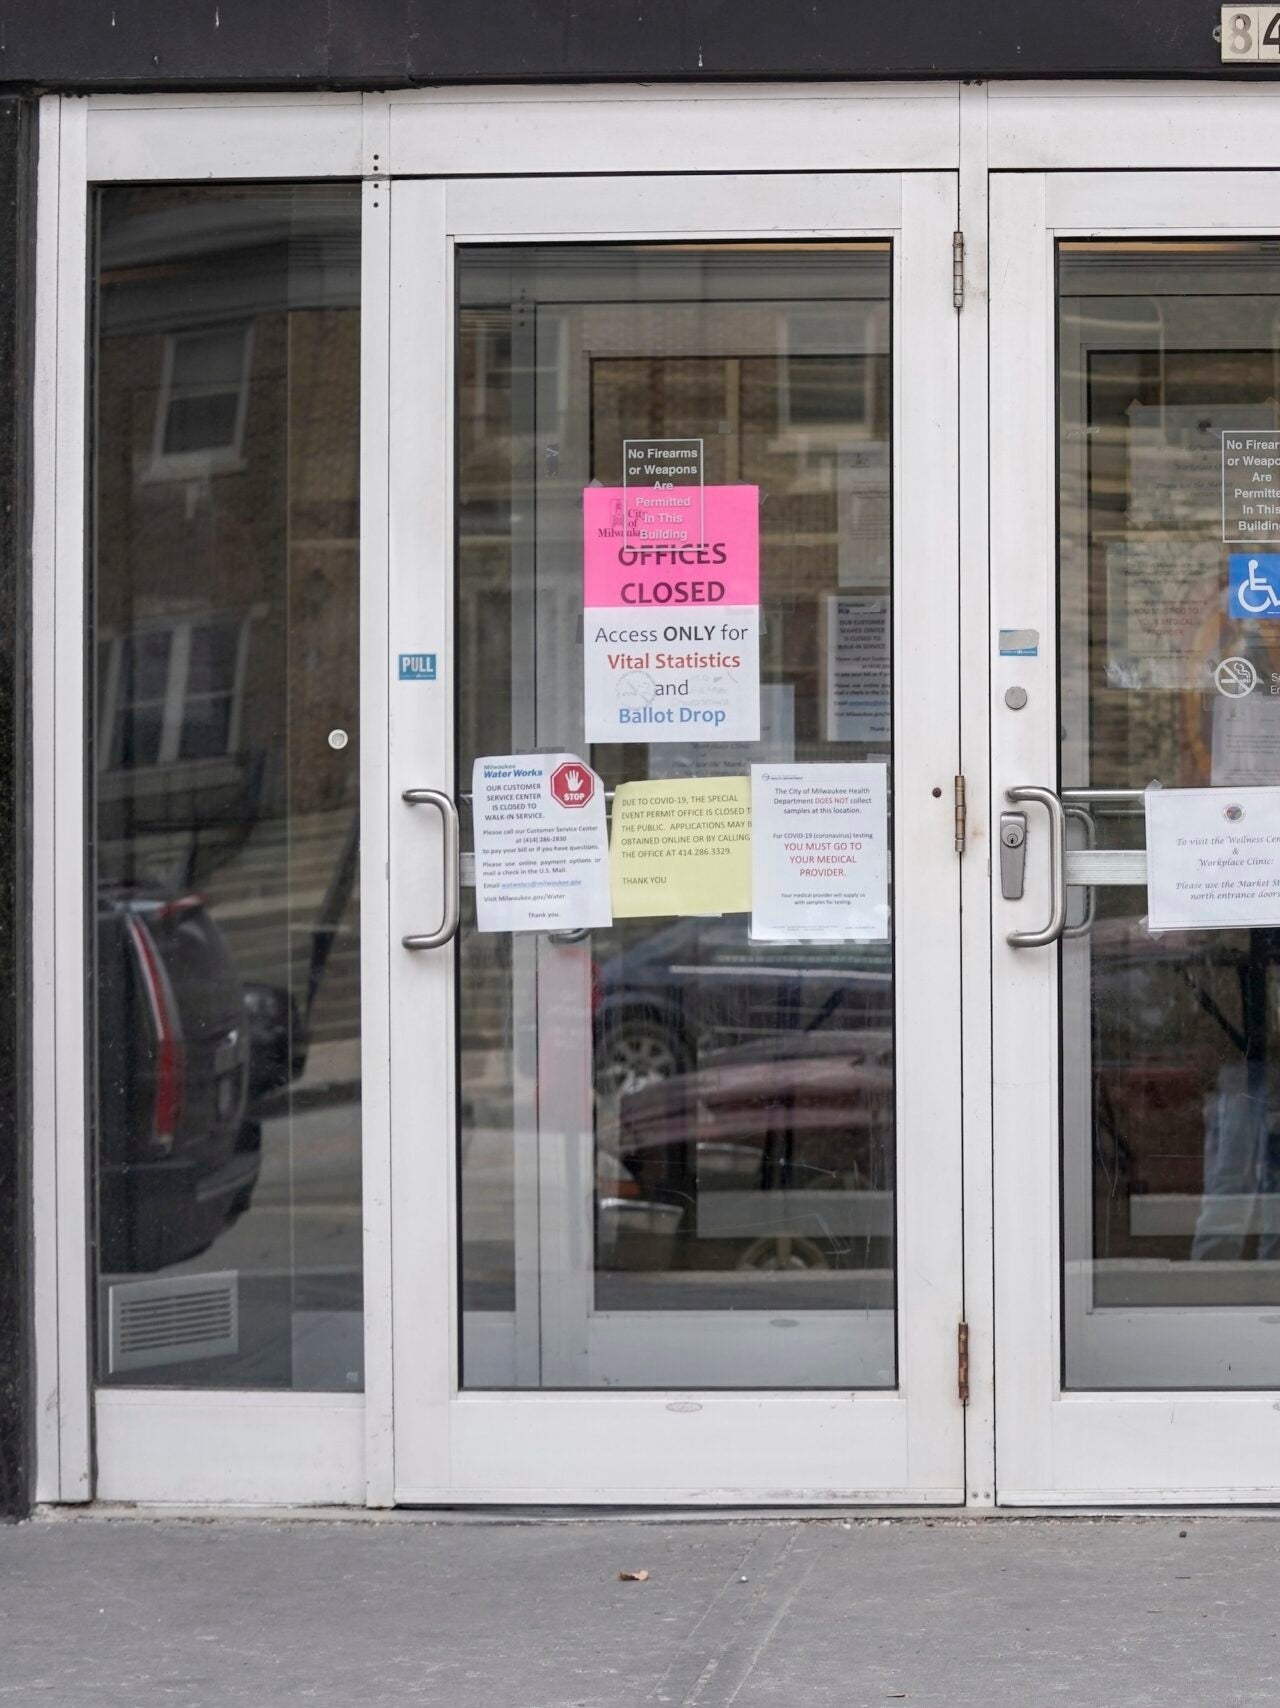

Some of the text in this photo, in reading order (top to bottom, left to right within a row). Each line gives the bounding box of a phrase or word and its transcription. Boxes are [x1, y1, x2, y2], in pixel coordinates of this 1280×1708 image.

[1226, 440, 1243, 450] No
[628, 448, 698, 458] No Firearms
[1227, 458, 1240, 466] or
[629, 464, 698, 476] or Weapons
[1252, 473, 1272, 482] Are
[654, 481, 674, 490] Are
[636, 497, 691, 506] Permitted
[628, 509, 648, 520] City
[1242, 505, 1253, 514] In
[644, 512, 683, 523] In This
[628, 520, 638, 528] of
[640, 530, 688, 540] Building
[618, 543, 727, 567] OFFICES
[620, 580, 726, 604] CLOSED
[595, 623, 748, 644] Access ONLY for
[402, 656, 434, 672] PULL
[607, 652, 741, 670] Vital Statistics
[655, 679, 690, 697] and
[619, 706, 726, 728] Ballot Drop
[484, 768, 543, 778] Water Works
[486, 784, 500, 792] OUR
[486, 794, 514, 802] SERVICE
[564, 792, 585, 800] STOP
[638, 798, 648, 806] TO
[650, 796, 689, 804] COVID-19,
[708, 794, 739, 802] SPECIAL
[621, 808, 745, 820] EVENT PERMIT OFFICE IS CLOSED
[622, 824, 636, 832] THE
[637, 824, 666, 832] PUBLIC.
[670, 821, 726, 830] APPLICATIONS
[621, 837, 660, 846] OBTAINED
[662, 836, 691, 844] ONLINE
[706, 834, 716, 842] BY
[718, 834, 750, 842] CALLING
[1176, 838, 1186, 846] To
[1190, 837, 1208, 846] visit
[1228, 835, 1264, 844] Wellness
[784, 842, 862, 850] YOU MUST GO TO
[638, 850, 664, 858] OFFICE
[790, 856, 856, 864] YOUR MEDICAL
[1198, 858, 1244, 868] Workplace
[800, 868, 846, 876] PROVIDER.
[650, 876, 667, 884] YOU
[1176, 882, 1202, 890] Please
[1221, 880, 1235, 888] the
[1238, 880, 1270, 888] Market
[1190, 892, 1214, 901] north
